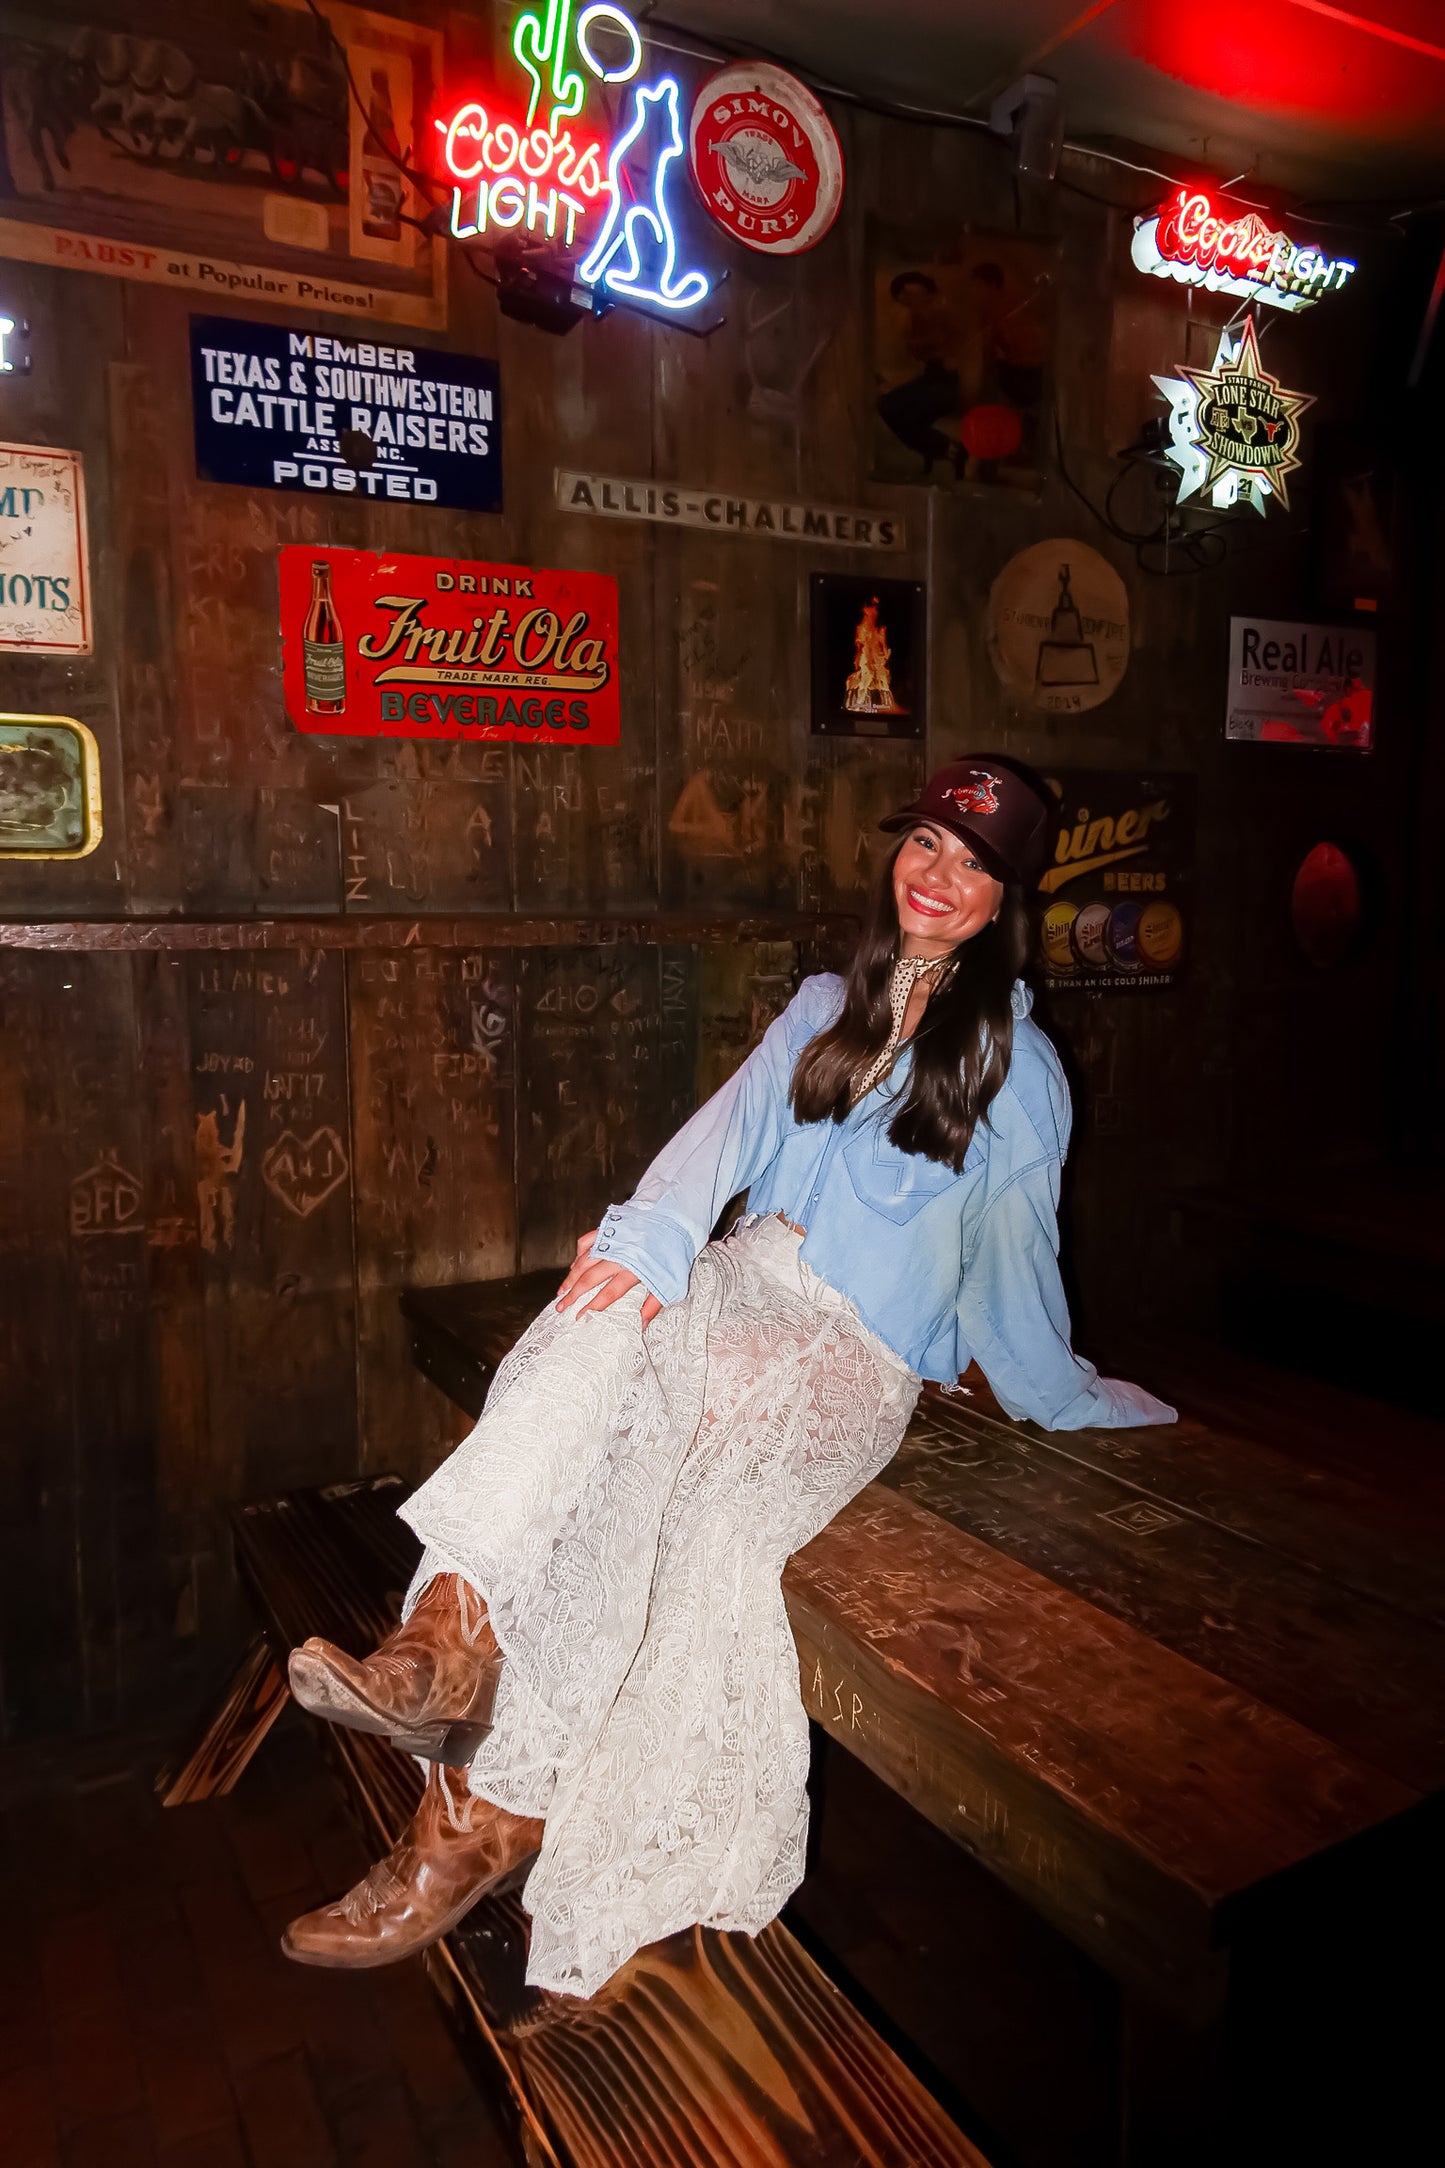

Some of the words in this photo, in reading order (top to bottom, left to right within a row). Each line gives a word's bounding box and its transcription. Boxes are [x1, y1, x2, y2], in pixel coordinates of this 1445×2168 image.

[434, 103, 601, 197] Coors
[451, 178, 586, 248] LIGHT
[712, 186, 799, 234] PURE
[55, 235, 157, 270] PABST
[166, 260, 190, 277] at
[199, 262, 289, 294] Popular
[298, 281, 375, 309] Prices!
[1269, 243, 1355, 289] LIGHT
[288, 333, 416, 373] MEMBER
[201, 348, 281, 391] TEXAS
[289, 362, 308, 395] &
[315, 365, 493, 421] SOUTHWESTERN
[1228, 376, 1247, 385] STATE
[211, 388, 336, 437] CATTLE
[351, 407, 489, 456] RAISERS
[1214, 385, 1247, 407] LONE
[1249, 388, 1280, 420] STAR
[1211, 431, 1281, 465] SHOWDOWN
[273, 460, 438, 500] POSTED
[571, 479, 896, 546] ALLIS-CHALMERS
[436, 572, 534, 598] DRINK
[358, 595, 608, 673] Fruit-Ola
[1242, 628, 1307, 674] Real
[1316, 637, 1363, 677] Ale
[437, 670, 478, 682] TRADE
[482, 672, 520, 684] MARK
[1241, 670, 1289, 692] Brewing
[381, 691, 590, 729] BEVERAGES
[1103, 872, 1166, 891] BEERS
[1059, 979, 1081, 987] THAN
[1084, 979, 1096, 987] AN
[1099, 976, 1112, 986] ICE
[1114, 976, 1136, 986] COLD
